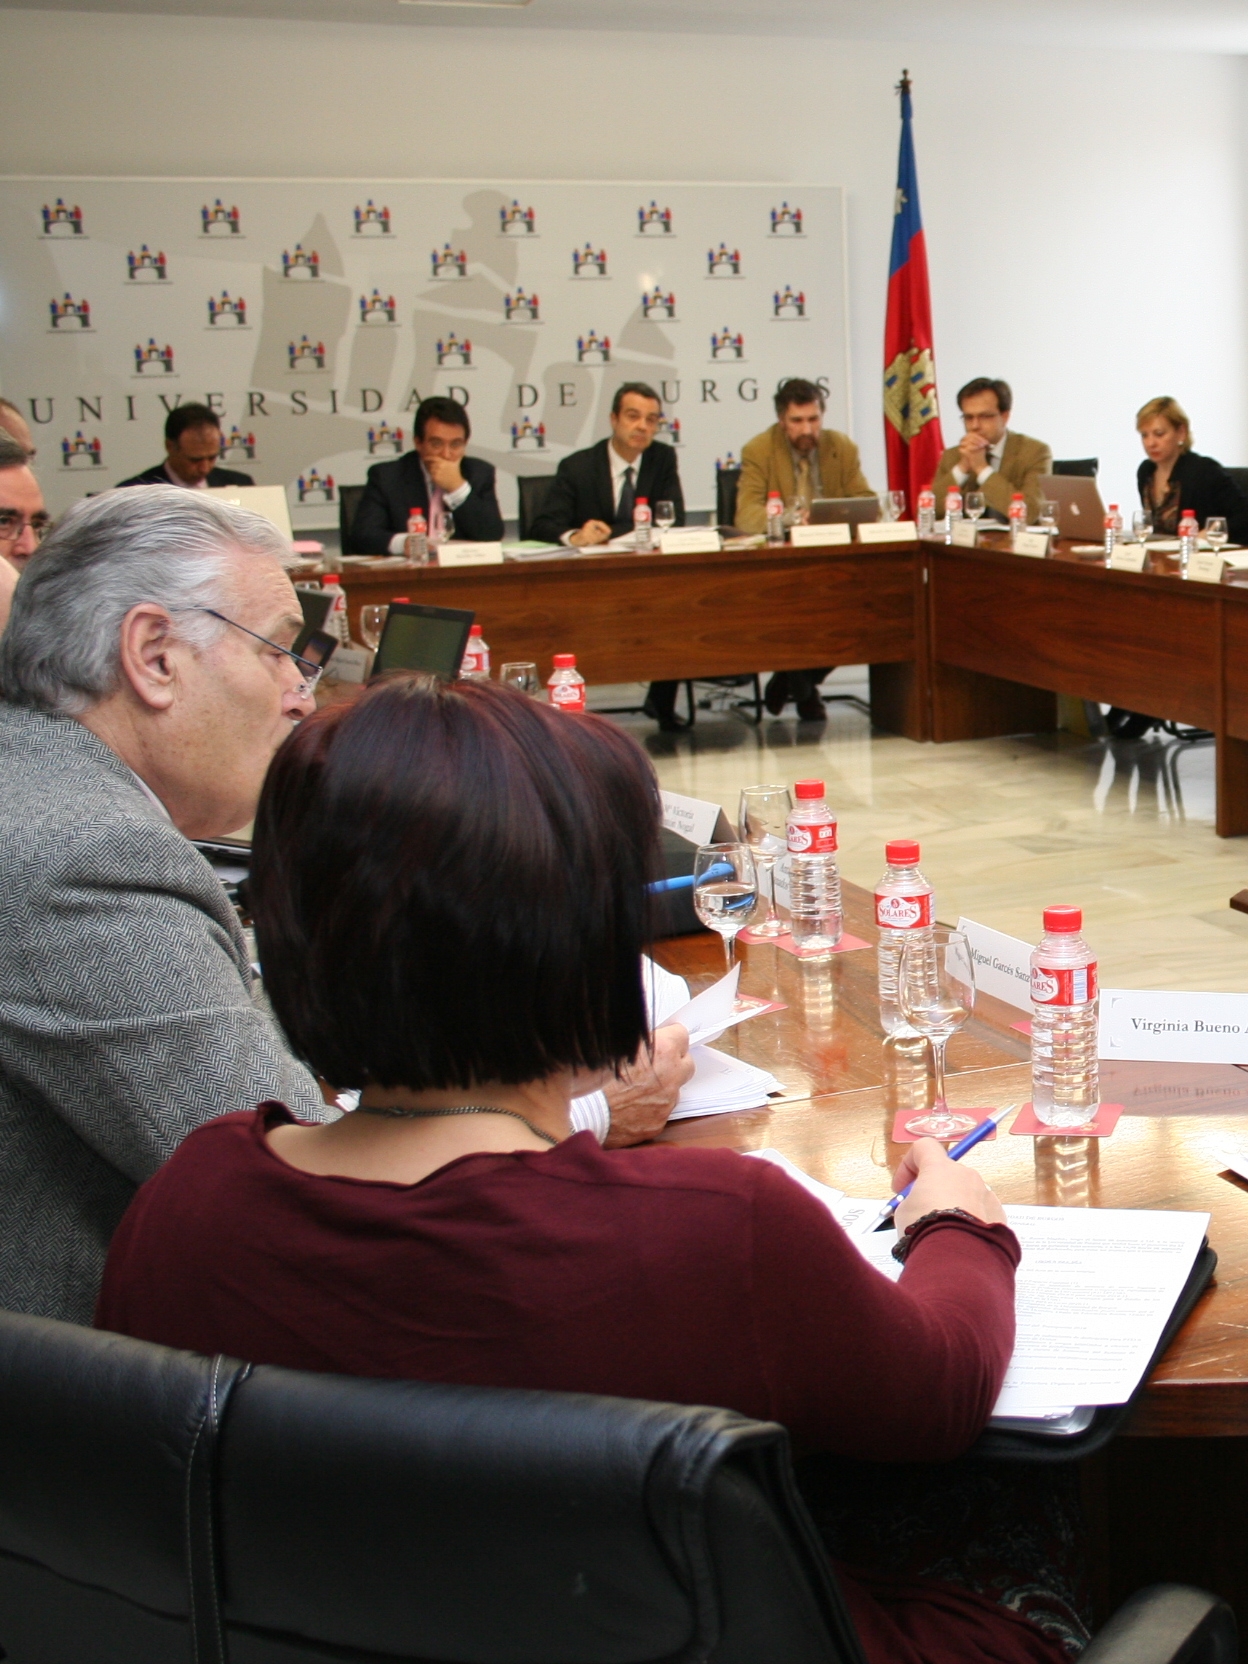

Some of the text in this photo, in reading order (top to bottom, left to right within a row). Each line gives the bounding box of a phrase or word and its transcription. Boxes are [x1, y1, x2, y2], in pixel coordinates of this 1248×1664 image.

[517, 382, 578, 408] DE
[621, 376, 830, 404] URGS
[880, 905, 917, 918] SOLARES
[970, 947, 1031, 983] Miguel Garcés Sanz
[1130, 1018, 1189, 1035] Virginia
[1193, 1020, 1241, 1034] Bueno
